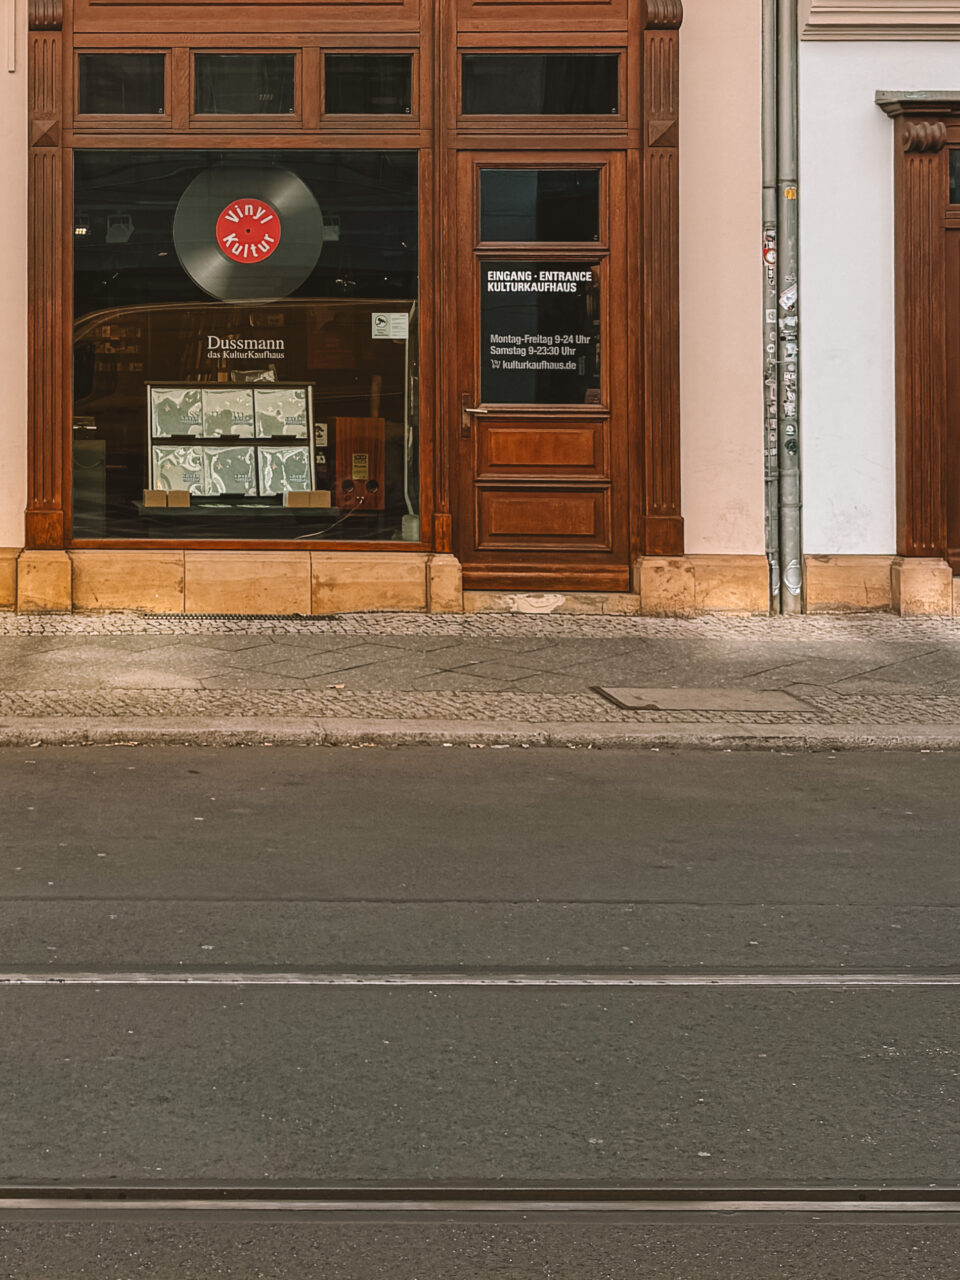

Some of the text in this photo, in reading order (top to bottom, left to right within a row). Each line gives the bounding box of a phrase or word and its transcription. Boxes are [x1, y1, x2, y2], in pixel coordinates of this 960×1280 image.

[224, 204, 273, 224] Vinyl
[223, 233, 274, 258] Kultur
[487, 271, 592, 281] EINGANG ENTRANCE
[487, 282, 577, 292] KULTURKAUFHAUS
[207, 335, 285, 350] Dussmann
[490, 334, 591, 345] Montag-Freitag 9-24 Uhr
[207, 350, 285, 359] das KulturKaufhaus
[490, 346, 576, 356] Samstag 9-23:30 Uhr
[502, 360, 577, 370] kulturkaufhaus.de
